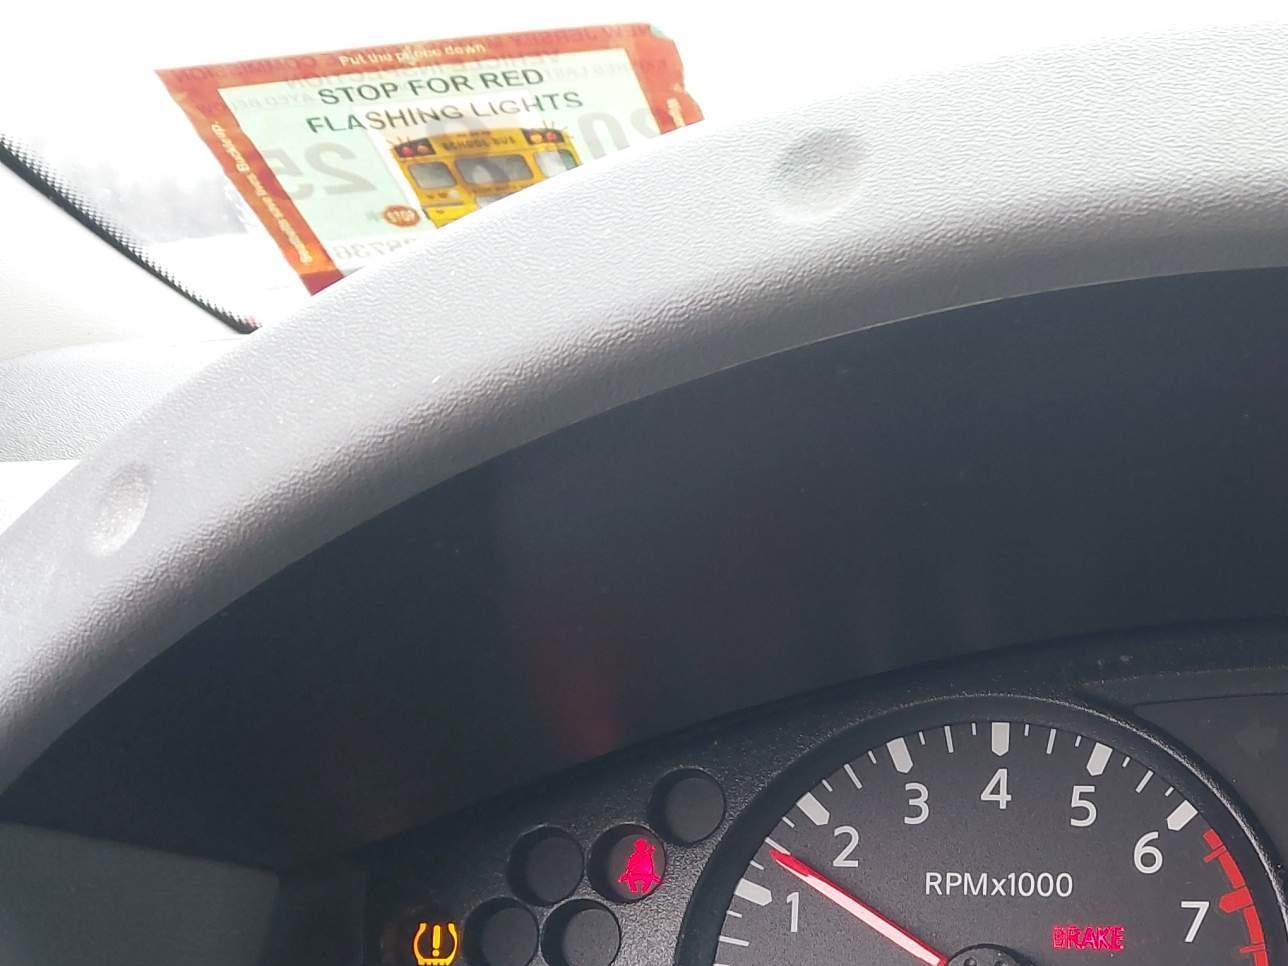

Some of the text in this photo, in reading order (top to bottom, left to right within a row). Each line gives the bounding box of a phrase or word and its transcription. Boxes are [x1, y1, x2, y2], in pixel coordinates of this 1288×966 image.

[337, 52, 366, 68] Put
[443, 43, 487, 57] down
[317, 81, 399, 105] STOP
[408, 75, 476, 97] FOR
[479, 68, 545, 90] RED
[305, 91, 585, 135] FLASHING LIGHTS
[905, 783, 928, 824] 3
[981, 769, 1011, 809] 4
[1071, 786, 1096, 826] 5
[833, 826, 858, 867] 2
[1134, 832, 1162, 873] 6
[926, 873, 1072, 896] RPMx1000
[787, 892, 799, 932] 1
[1181, 902, 1209, 942] 7
[1053, 927, 1124, 950] BRAKE
